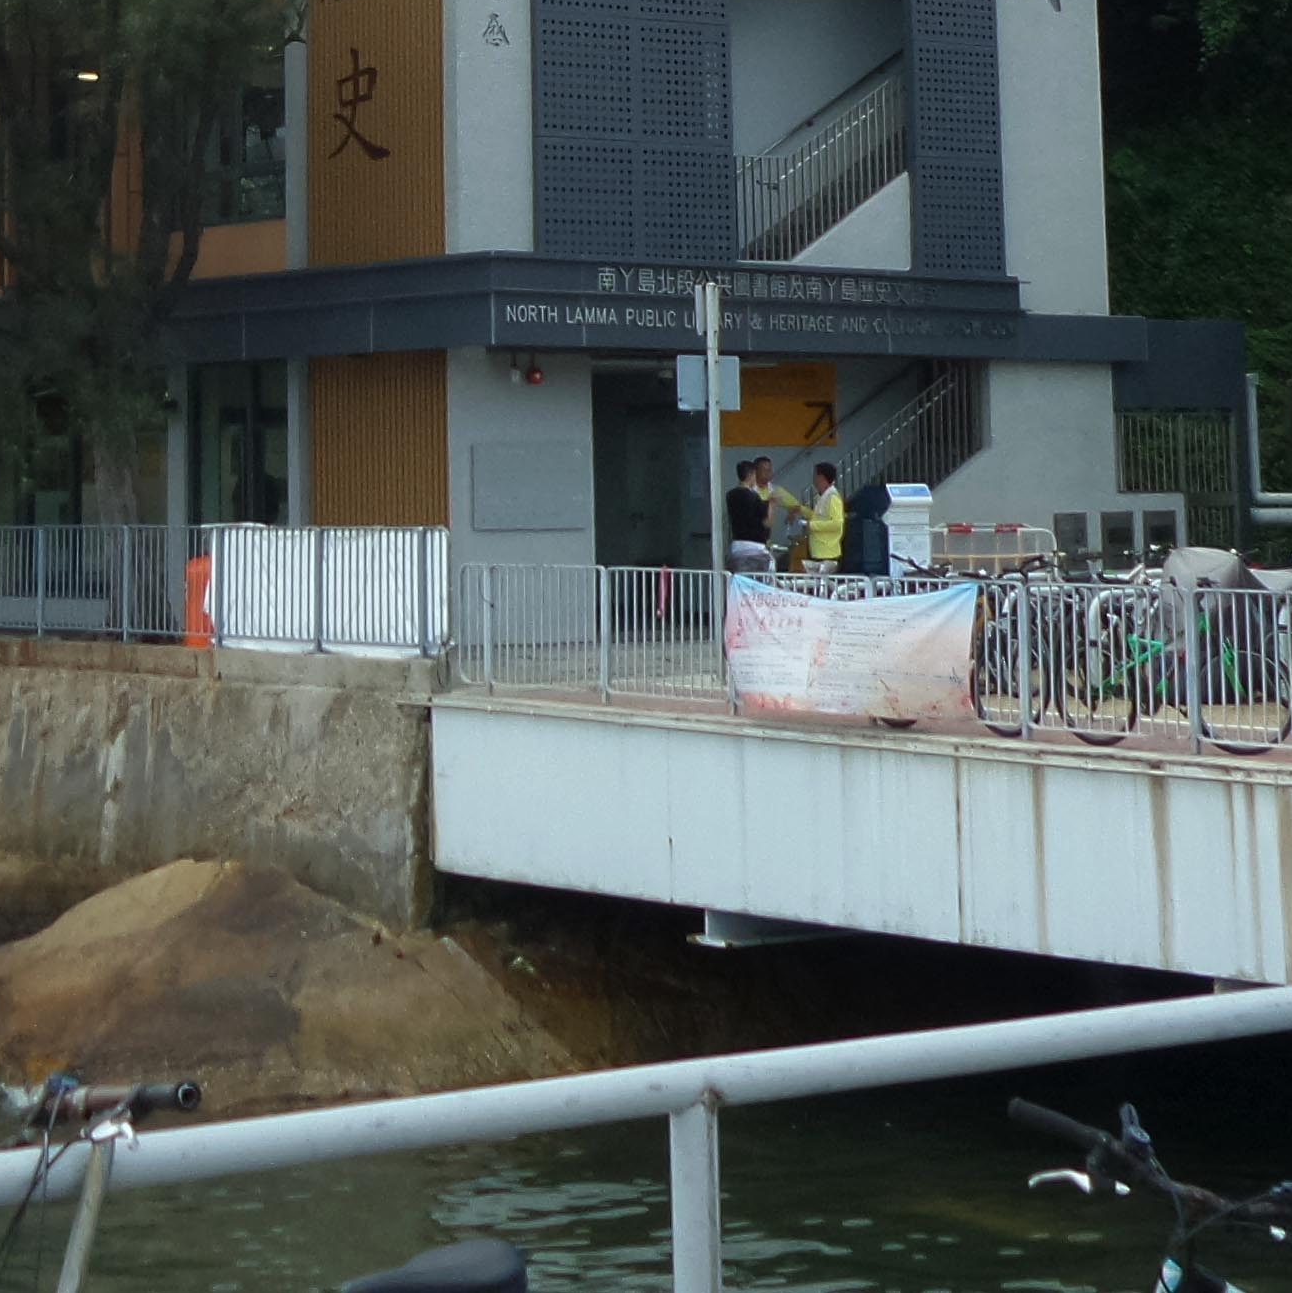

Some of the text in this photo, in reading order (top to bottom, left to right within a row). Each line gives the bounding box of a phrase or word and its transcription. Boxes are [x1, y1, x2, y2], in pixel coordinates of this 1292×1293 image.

[506, 305, 558, 324] NORTH
[566, 306, 618, 325] LAMMA
[626, 308, 677, 327] PUBLIC
[684, 310, 742, 330] LIRY
[750, 313, 763, 330] &
[769, 314, 836, 333] HERITAGE
[842, 315, 867, 334] AND
